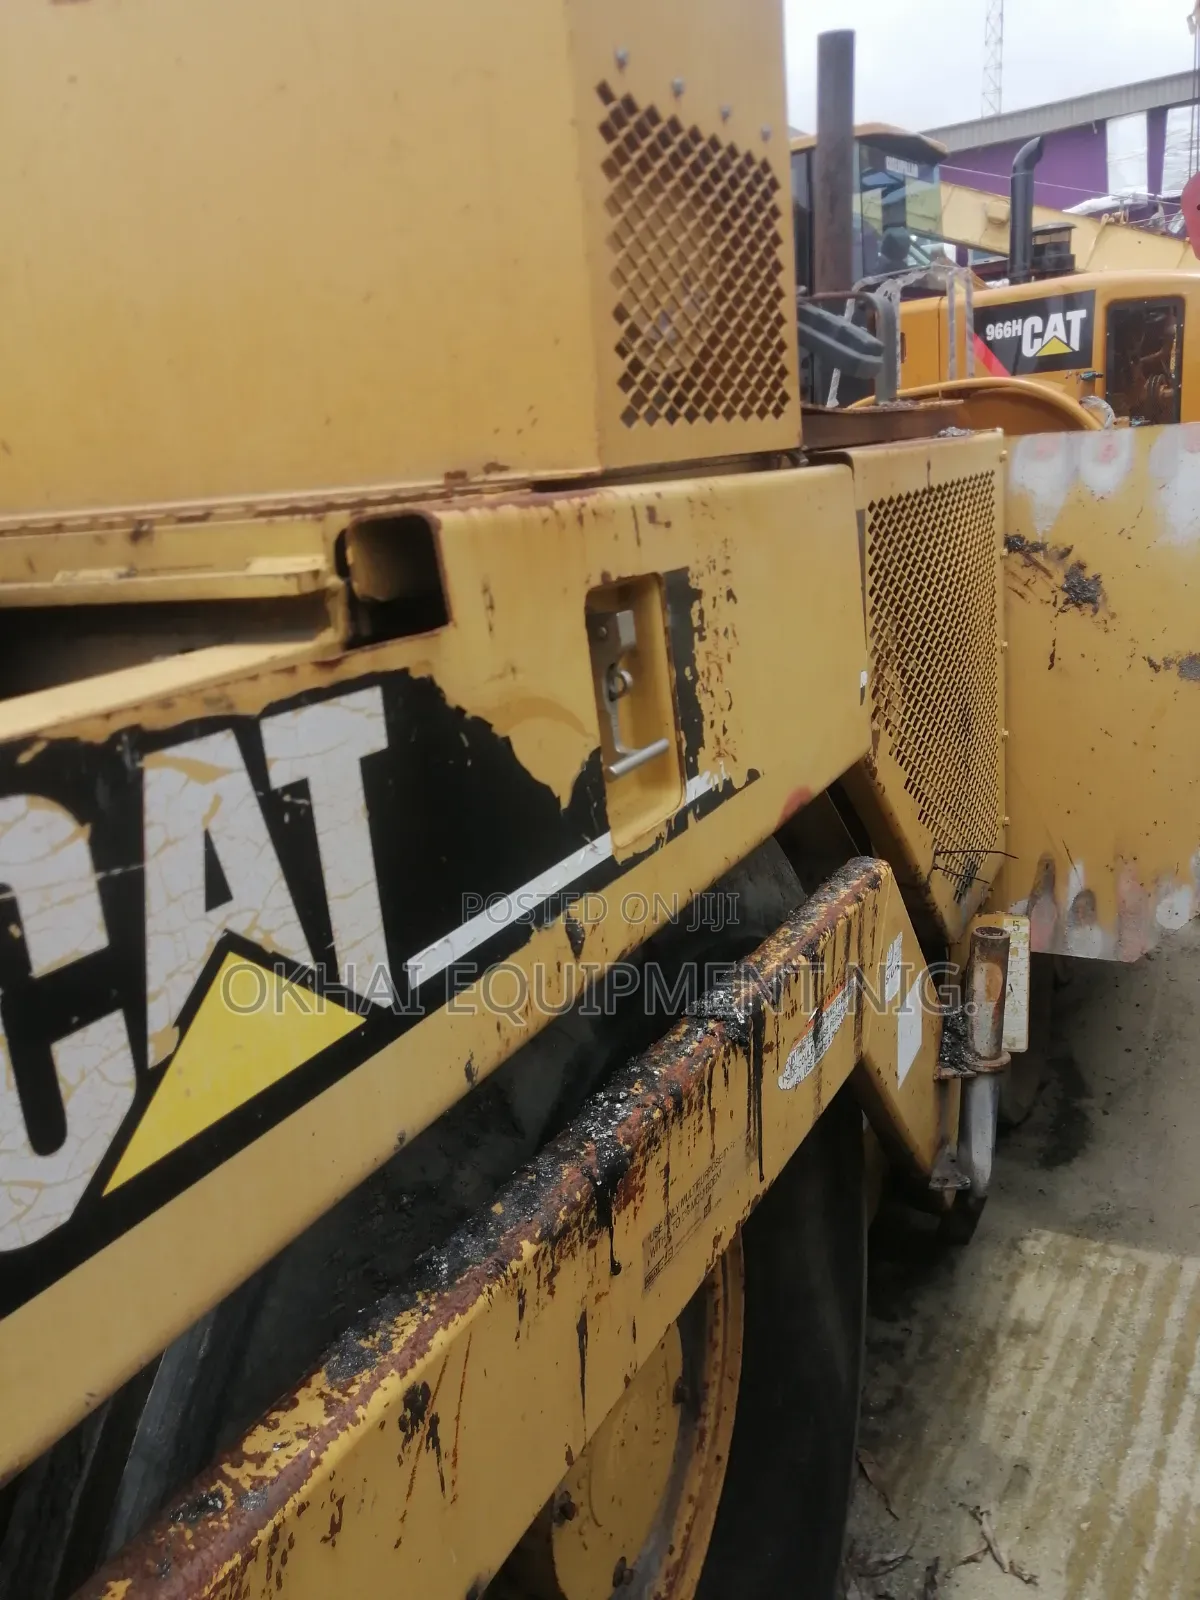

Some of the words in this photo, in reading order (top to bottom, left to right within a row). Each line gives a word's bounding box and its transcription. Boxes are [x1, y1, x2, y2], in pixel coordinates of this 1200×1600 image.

[986, 319, 1022, 341] 966H
[1021, 309, 1087, 358] CAT
[0, 686, 389, 1252] CAT
